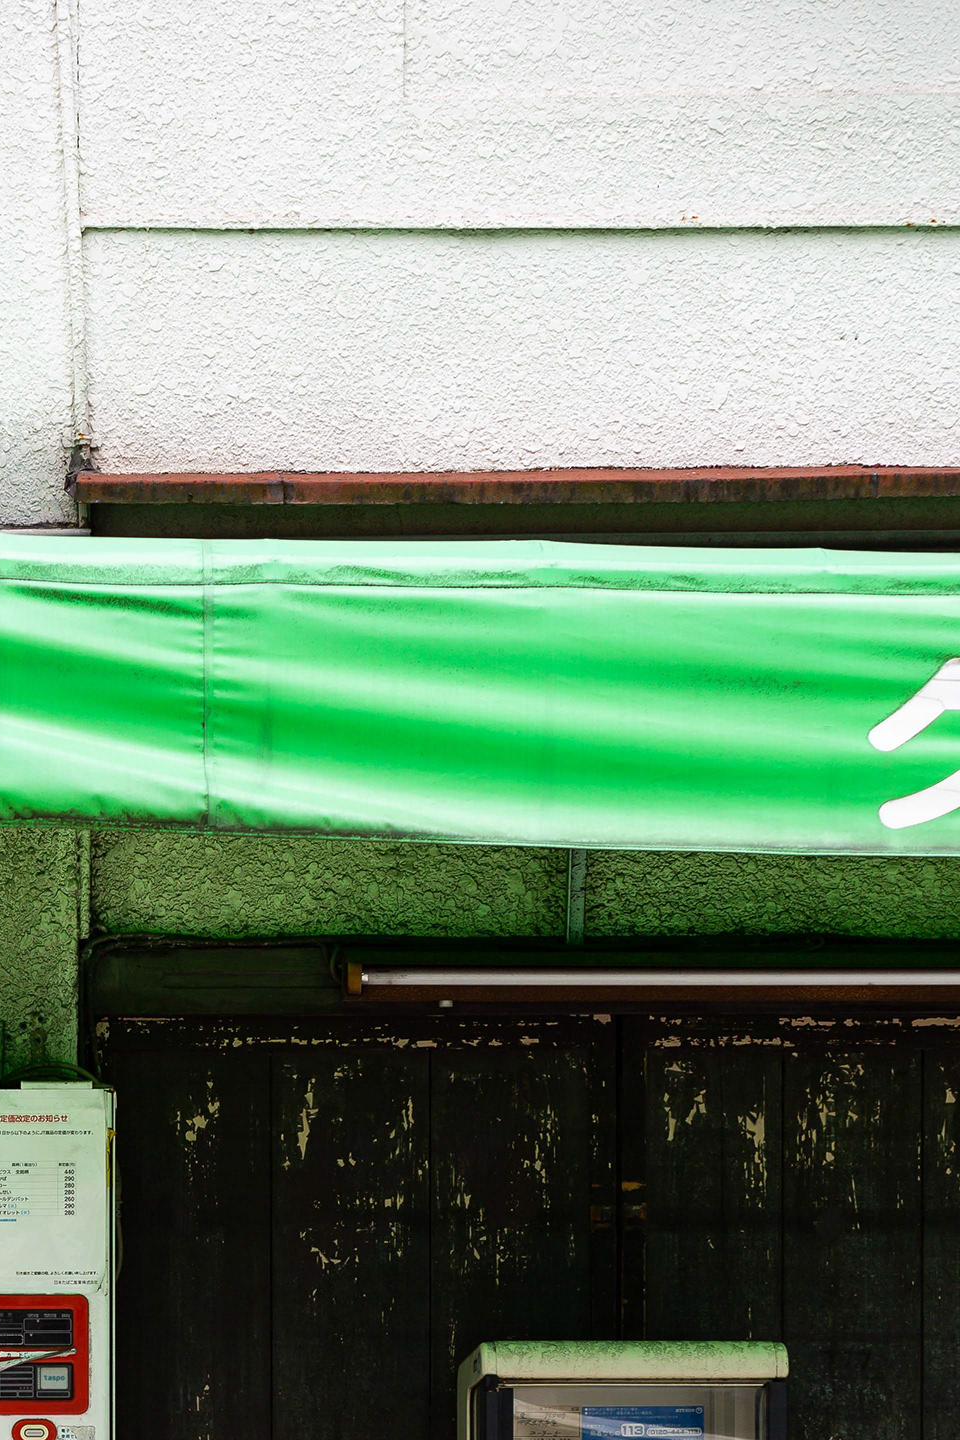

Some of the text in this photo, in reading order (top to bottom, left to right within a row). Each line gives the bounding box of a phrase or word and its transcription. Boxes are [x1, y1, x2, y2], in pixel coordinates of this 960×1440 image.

[0, 1115, 68, 1123] 定価改定のお知らせ
[44, 1374, 66, 1385] taspo
[621, 1425, 644, 1436] 113
